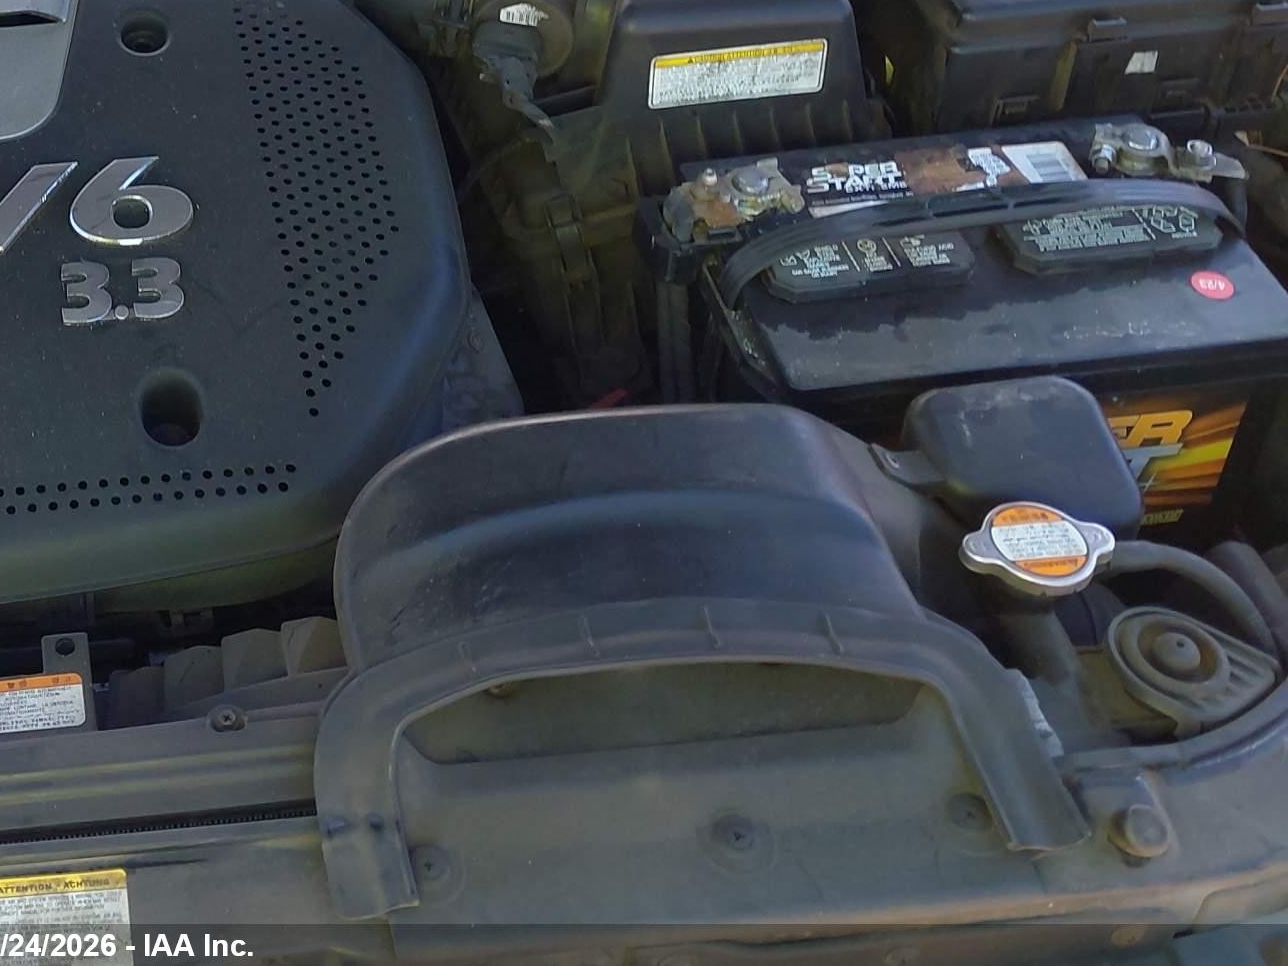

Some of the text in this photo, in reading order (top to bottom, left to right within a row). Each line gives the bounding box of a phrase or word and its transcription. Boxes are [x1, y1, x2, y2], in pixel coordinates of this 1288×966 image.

[810, 160, 904, 182] SPER
[806, 172, 903, 194] START
[61, 257, 185, 326] 3.3
[63, 878, 111, 890] ACHTUNG
